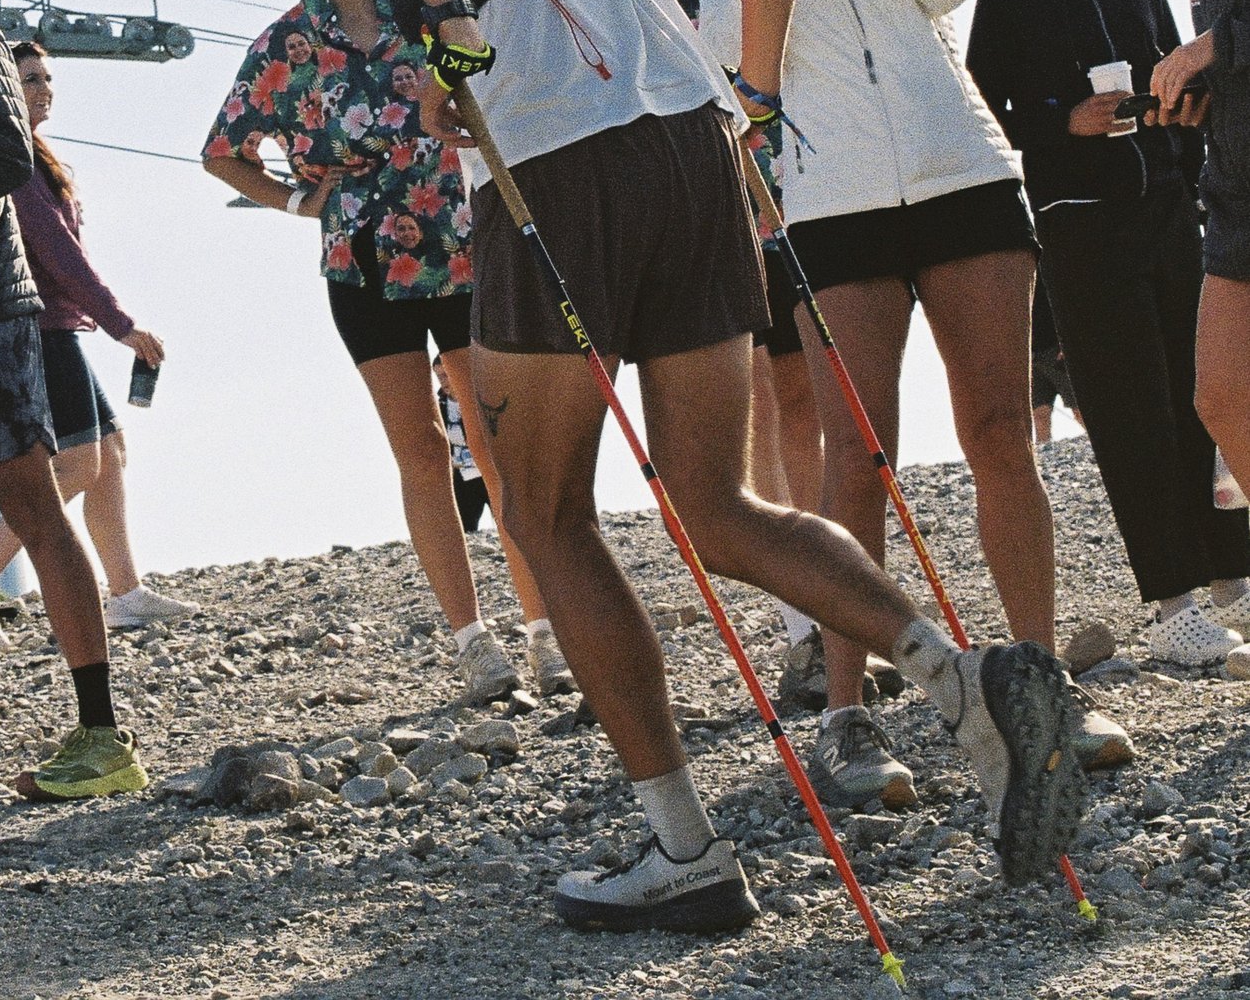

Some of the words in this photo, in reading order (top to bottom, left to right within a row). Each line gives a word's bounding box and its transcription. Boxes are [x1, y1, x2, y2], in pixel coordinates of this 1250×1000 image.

[441, 53, 482, 73] LEKI
[559, 300, 590, 349] LEKI
[674, 878, 685, 888] to
[686, 865, 721, 883] Coast
